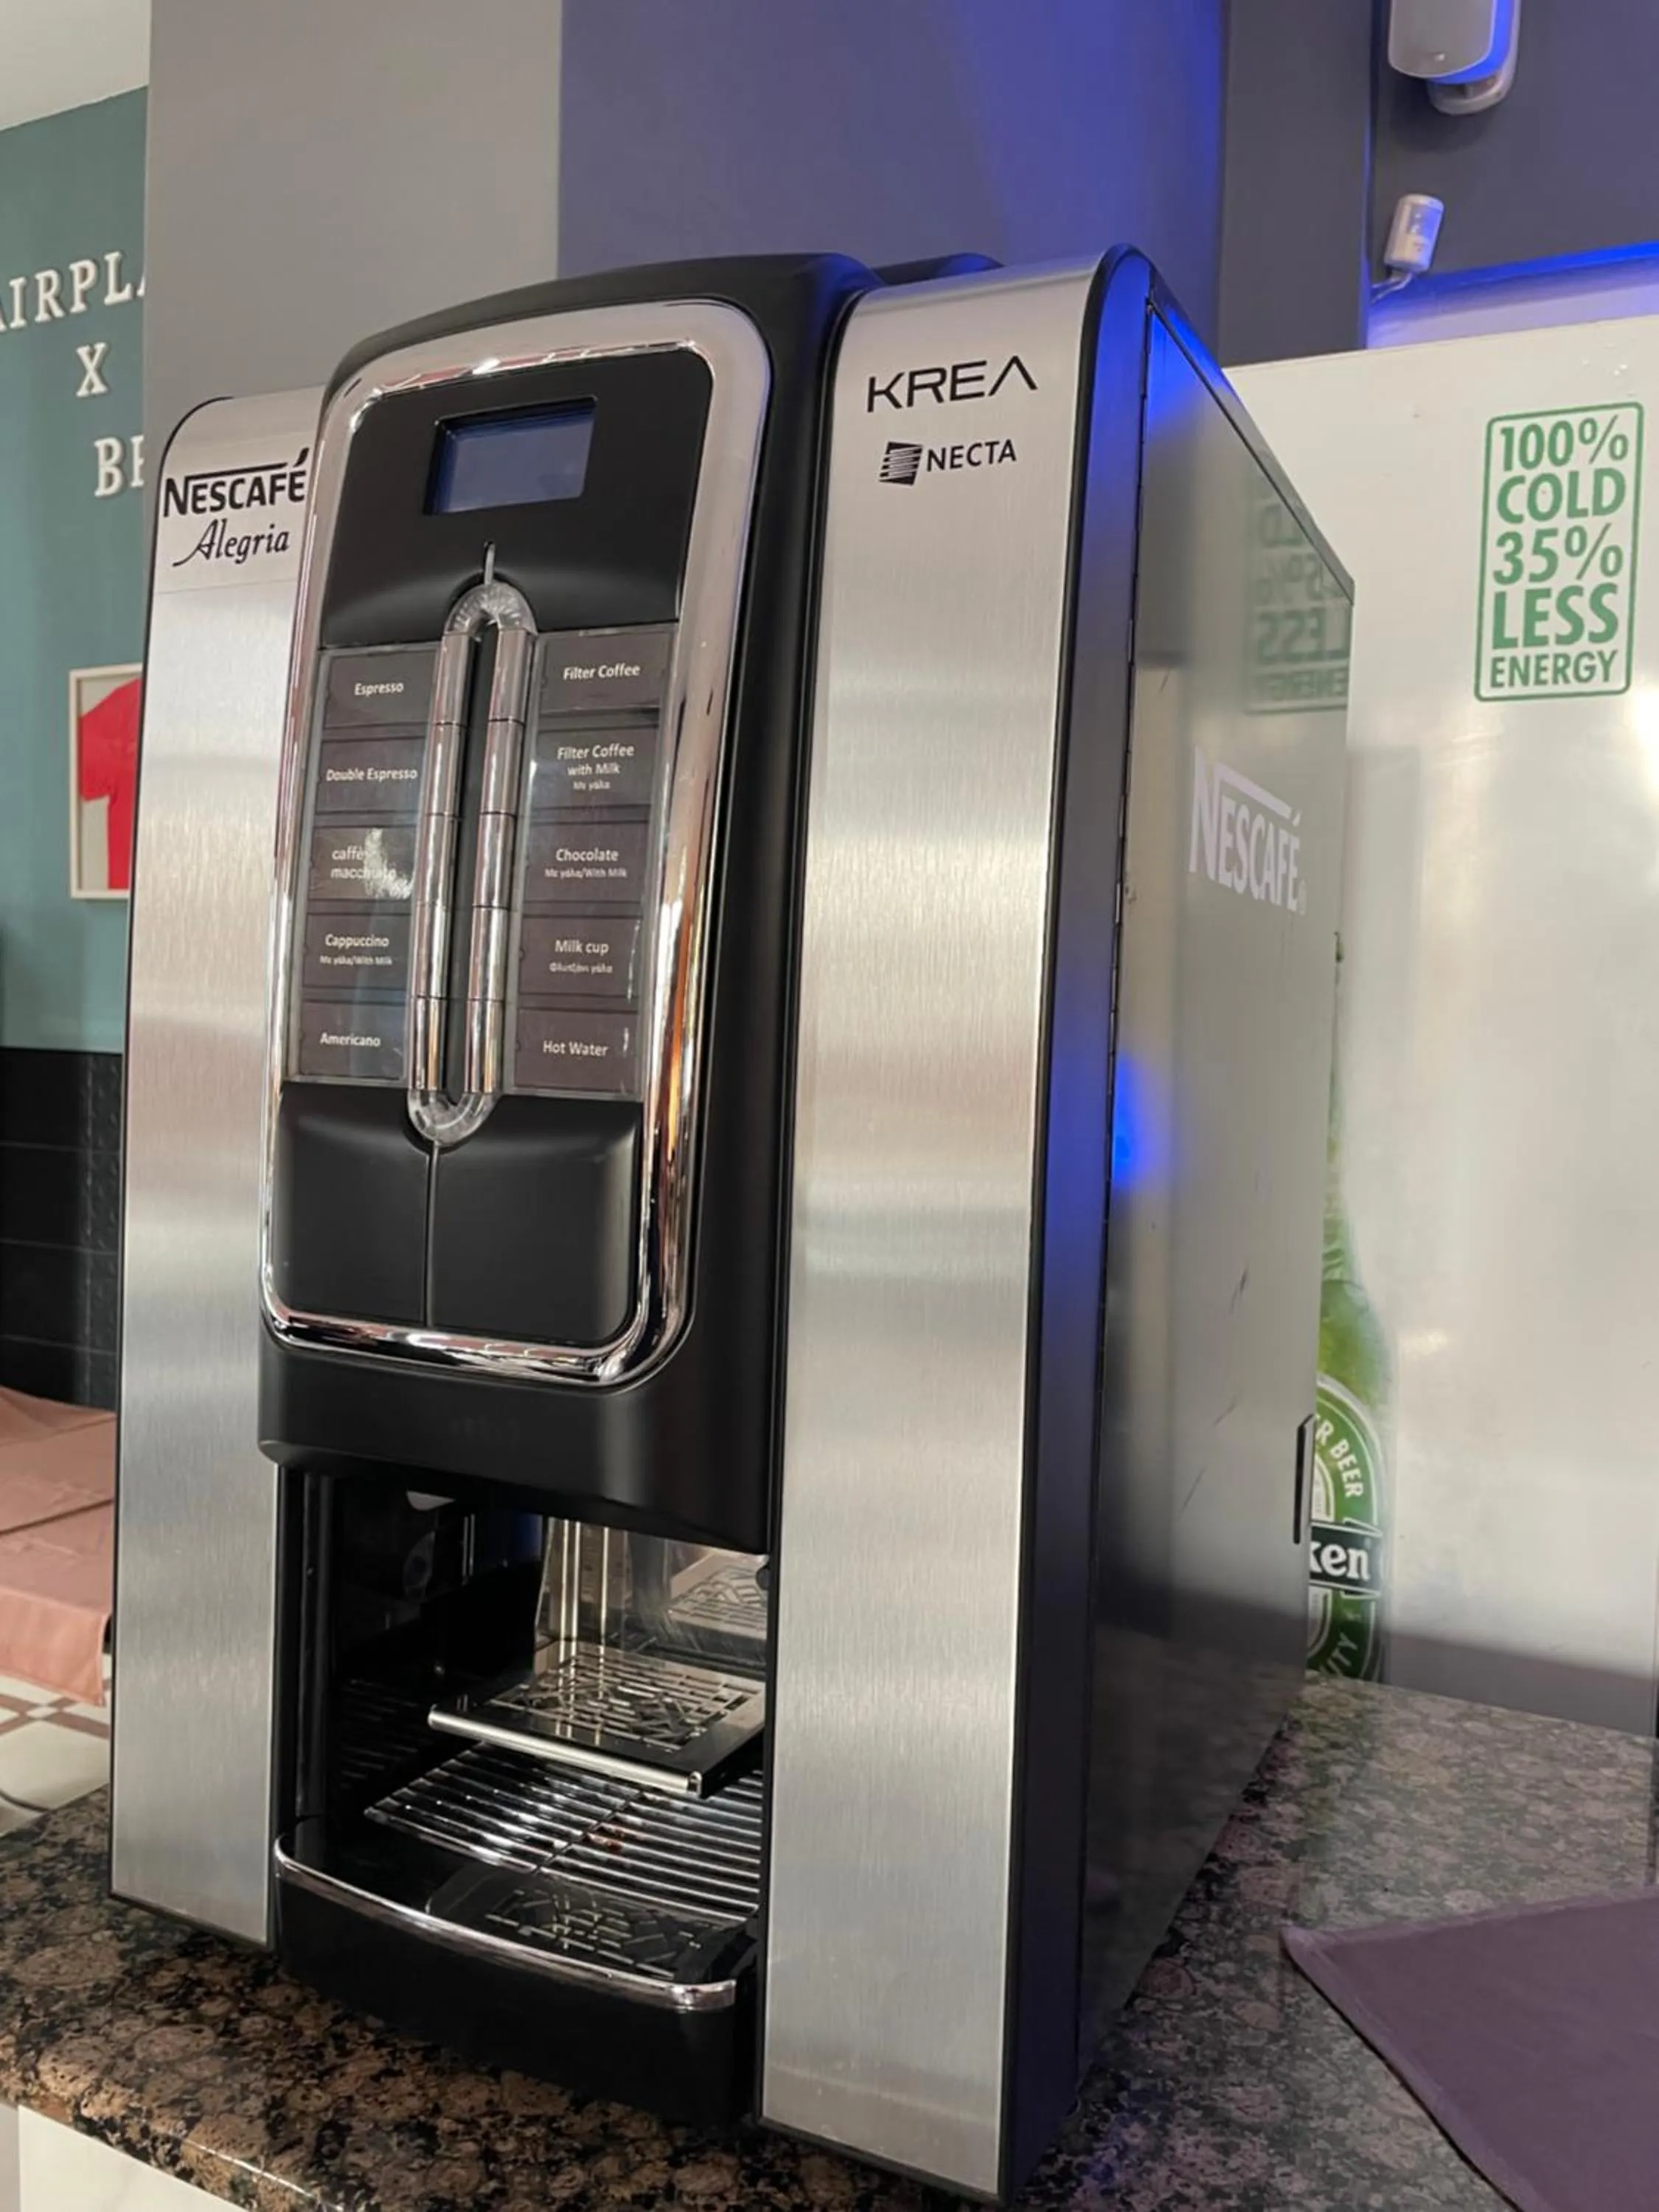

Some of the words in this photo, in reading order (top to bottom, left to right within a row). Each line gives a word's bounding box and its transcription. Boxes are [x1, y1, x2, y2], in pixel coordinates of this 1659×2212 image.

[0, 251, 145, 332] IRPL
[75, 341, 108, 397] X
[867, 355, 1038, 414] KREA
[926, 439, 1017, 472] NECTA
[1500, 414, 1629, 472] 100%
[1496, 467, 1627, 524] COLD
[172, 518, 290, 566] Alegria
[1492, 522, 1624, 586] 35%
[1492, 582, 1620, 650] LESS
[563, 667, 596, 681] Filter
[598, 662, 641, 678] Coffee
[1489, 649, 1618, 689] ENERGY
[354, 682, 404, 697] Espresso
[557, 746, 589, 760] Filter
[592, 742, 634, 758] Coffee
[326, 768, 365, 782] Double
[367, 768, 418, 782] Espresso
[567, 763, 593, 776] with
[595, 762, 621, 775] Milk
[555, 848, 619, 862] Chocolate
[325, 933, 390, 950] Cappuccino
[554, 939, 582, 953] Milk
[585, 942, 610, 956] cup
[319, 1032, 381, 1047] Americano
[543, 1040, 566, 1054] Hot
[568, 1041, 609, 1057] Water
[1329, 1438, 1364, 1498] BEER
